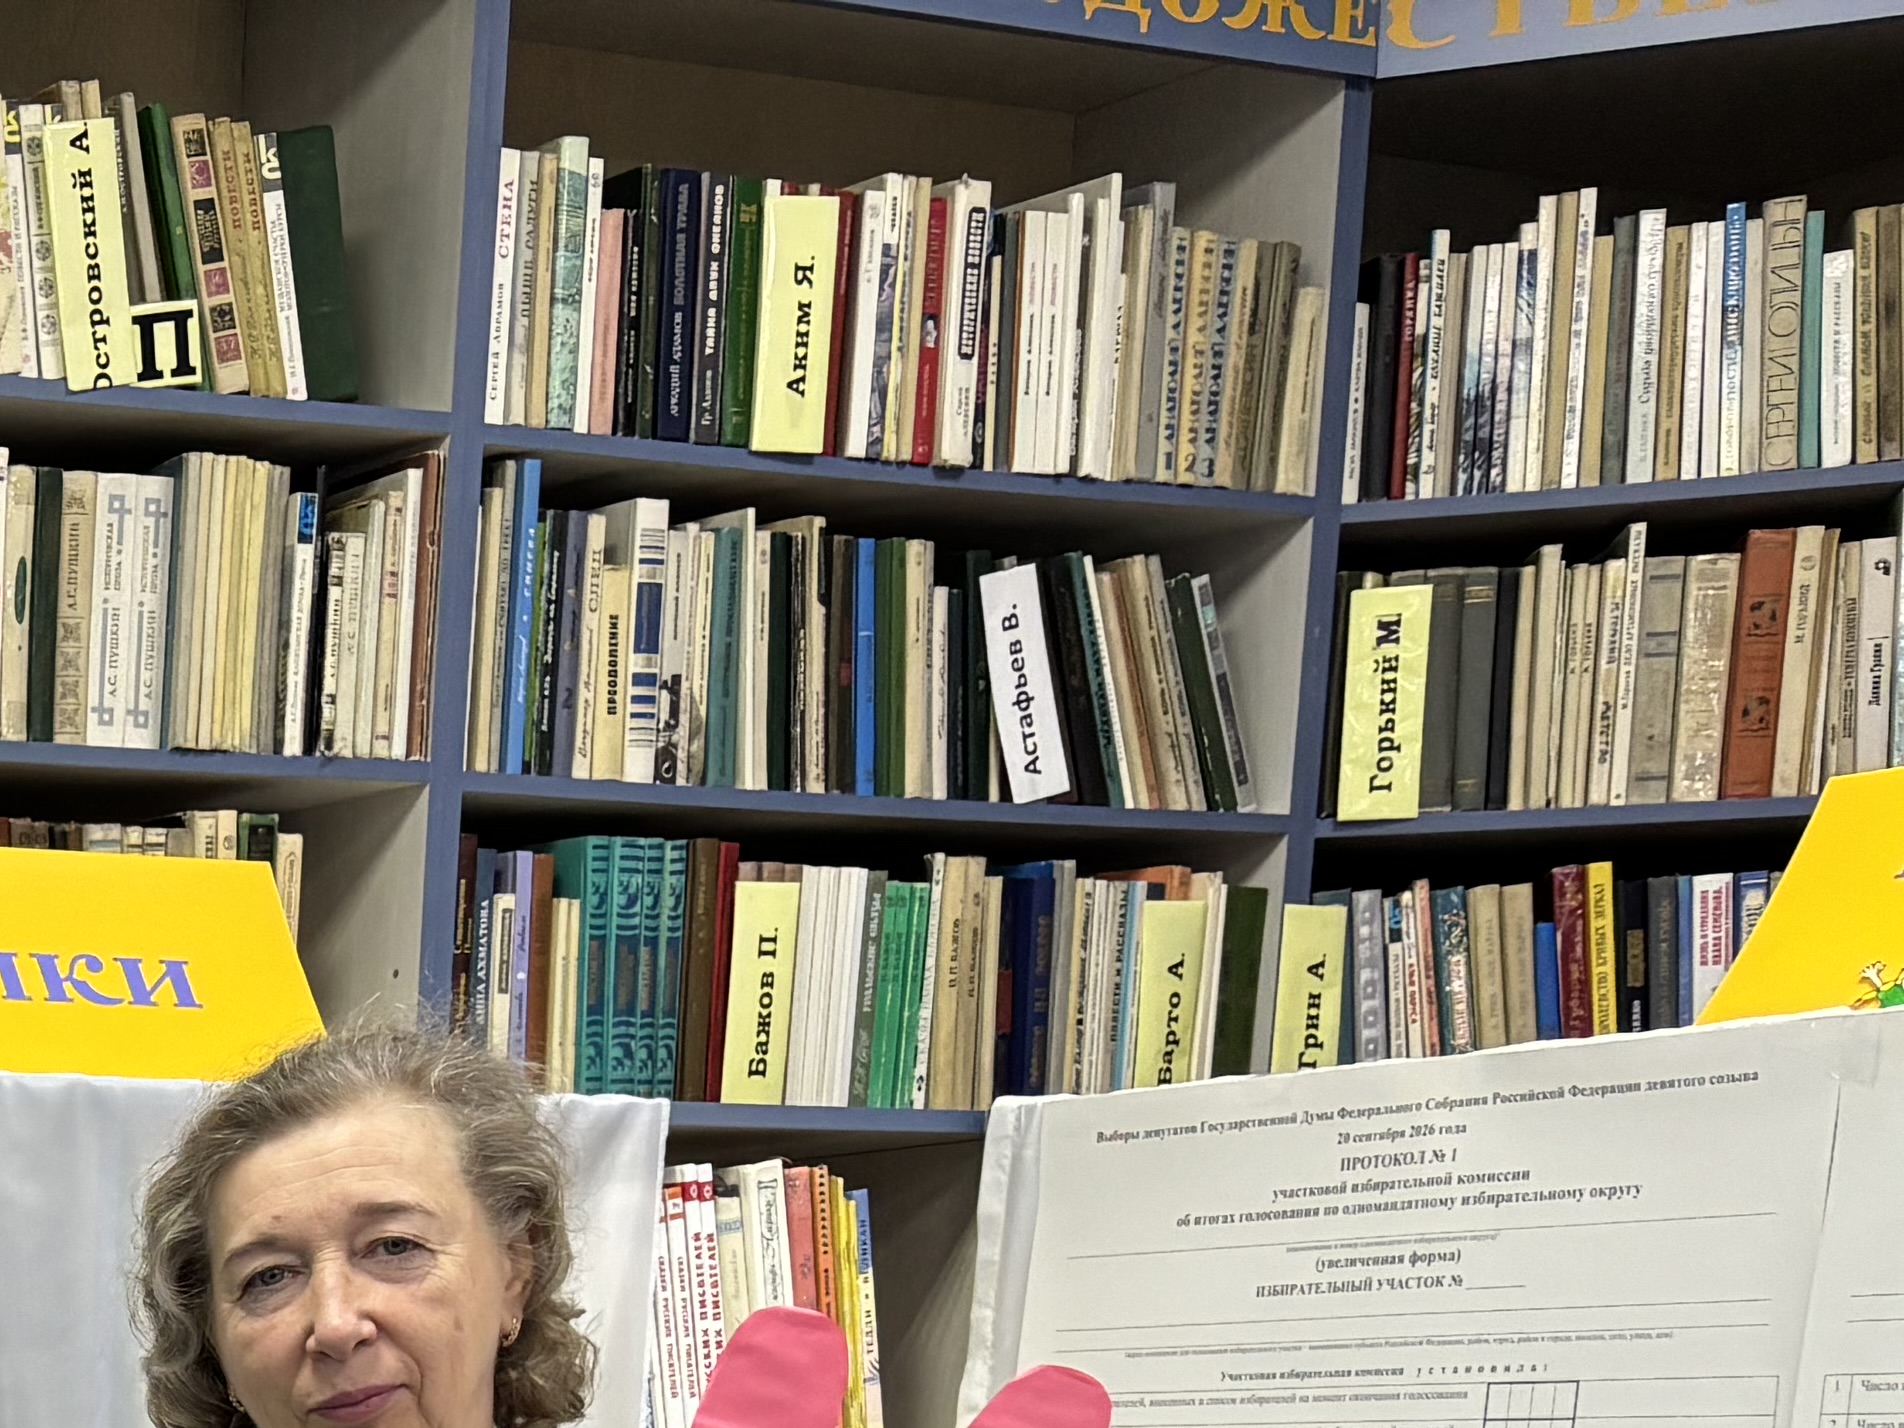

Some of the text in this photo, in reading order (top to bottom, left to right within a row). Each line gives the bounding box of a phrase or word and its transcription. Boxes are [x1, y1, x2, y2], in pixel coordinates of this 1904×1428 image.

[132, 309, 197, 381] П
[786, 255, 815, 398] Аким Я.
[1002, 602, 1042, 776] Астафьев В.
[1368, 653, 1400, 794] Горький
[748, 927, 777, 1078] Бажов П.
[1157, 953, 1185, 1086] Барто А.
[1298, 953, 1326, 1070] Грин А.
[1239, 1206, 1320, 1223] голосования
[1460, 1187, 1586, 1208] избирательному
[1589, 1184, 1643, 1201] округу
[1272, 1168, 1531, 1203] участковой избирательной комиссии
[1340, 1152, 1425, 1172] ПРОТОКОЛ
[1256, 1277, 1373, 1298] ИЗБИРАТЕЛЬНЫЙ
[1376, 1275, 1445, 1292] УЧАСТОК
[1315, 1247, 1461, 1273] (увеличенная форма)
